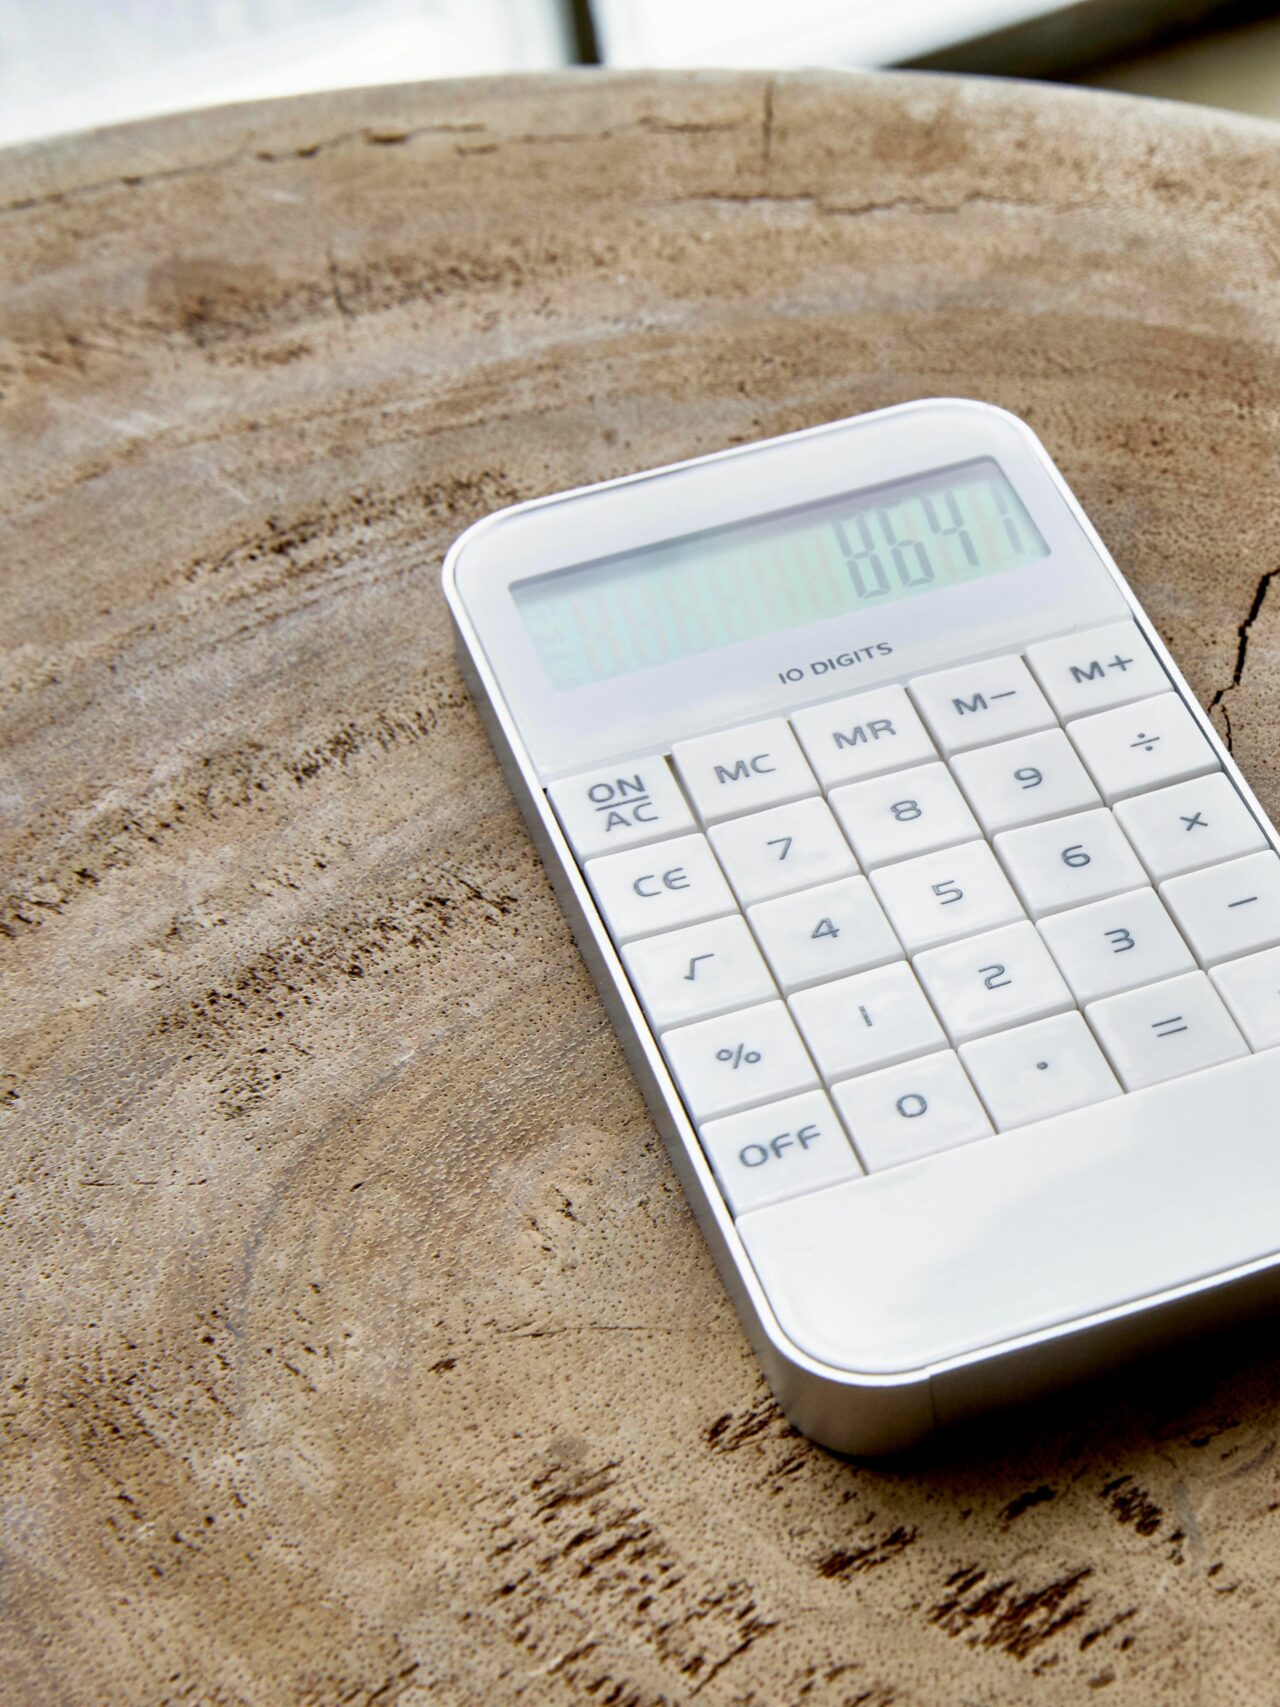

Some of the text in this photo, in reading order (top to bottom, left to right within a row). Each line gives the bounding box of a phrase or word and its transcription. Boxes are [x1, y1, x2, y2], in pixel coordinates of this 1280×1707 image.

[810, 641, 895, 676] DIGITS
[1069, 655, 1133, 683] M+
[832, 719, 896, 749] MR
[714, 754, 776, 784] MC
[1014, 768, 1043, 789] 9
[588, 775, 647, 802] ON
[605, 801, 659, 832] AC
[890, 800, 922, 821] 8
[767, 837, 792, 860] 7
[1061, 845, 1090, 867] 6
[633, 868, 690, 897] CE
[932, 880, 963, 905] 5
[811, 918, 840, 939] 4
[1104, 929, 1135, 953] 3
[978, 964, 1011, 990] 2
[716, 1043, 761, 1069] %
[739, 1125, 820, 1168] OFF
